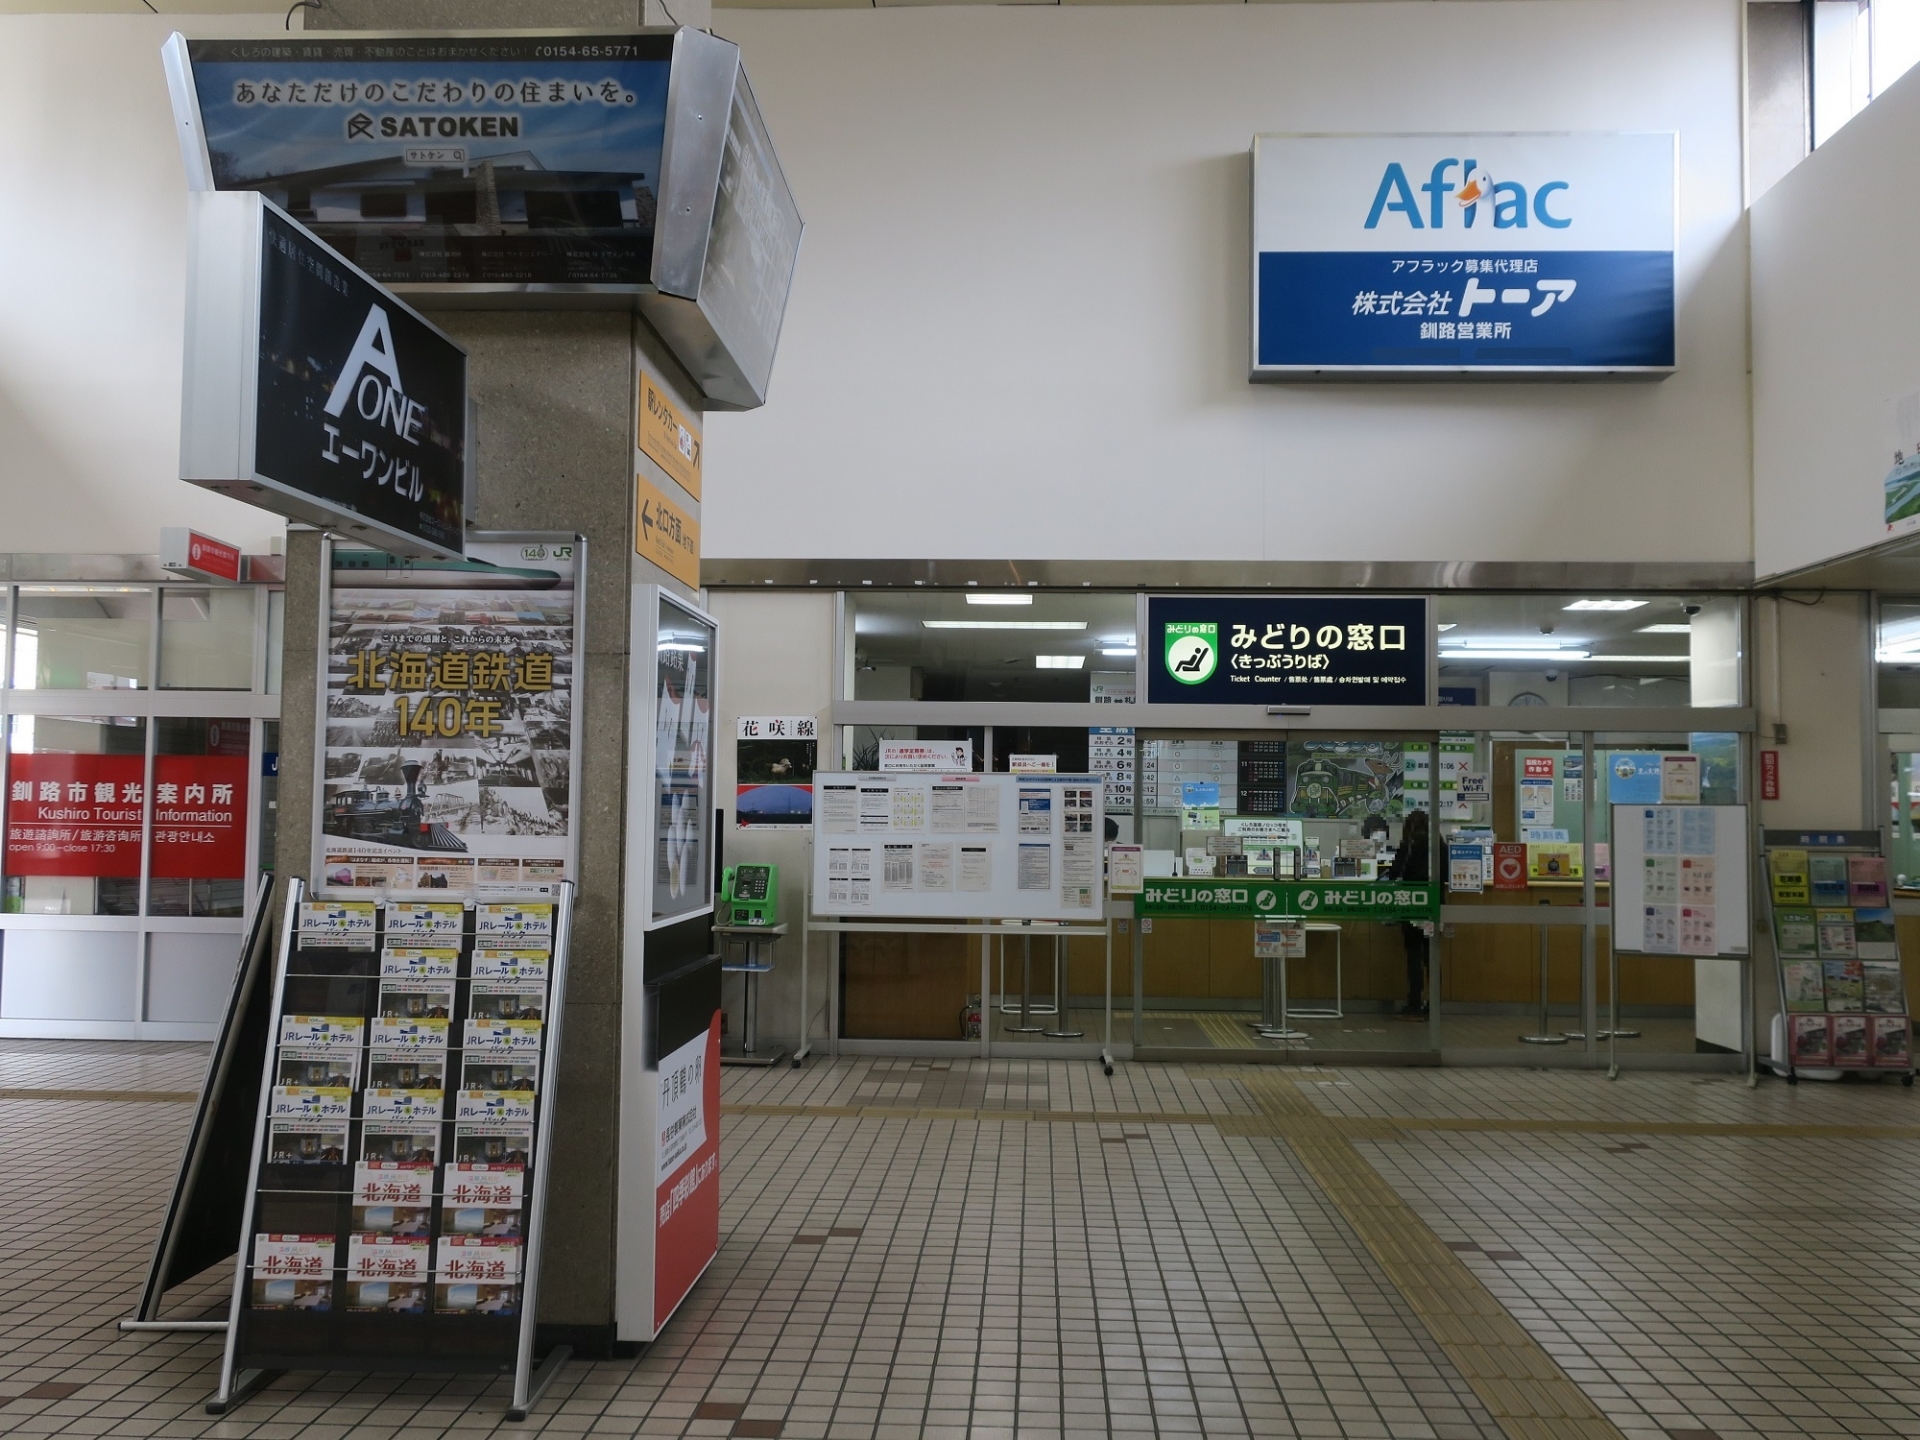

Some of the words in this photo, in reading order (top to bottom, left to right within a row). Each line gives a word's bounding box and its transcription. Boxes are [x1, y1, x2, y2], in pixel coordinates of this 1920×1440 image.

[543, 45, 640, 57] 0154-65-5771
[234, 79, 638, 105] あなただけのこだわりの住まいを。
[380, 116, 519, 138] SATOKEN
[409, 151, 445, 160] サトケン
[1363, 157, 1573, 230] Aflac
[1391, 259, 1538, 274] アフラック募集代理店
[1350, 290, 1453, 317] 株式会社
[1458, 277, 1577, 318] トーア
[1419, 321, 1512, 340] 釧路営業所
[323, 302, 404, 418] A
[357, 373, 426, 447] ONE
[647, 387, 678, 434] 駅レンタカー
[321, 422, 425, 503] エーワンビル
[655, 508, 682, 545] 北口方面
[553, 547, 572, 557] JR
[1166, 623, 1216, 634] みどりの窓口
[1231, 624, 1405, 651] みどりの窓口
[347, 650, 553, 691] 北海道鉄道
[394, 697, 503, 738] 140年
[742, 719, 814, 737] 花咲線
[1462, 776, 1484, 785] Free
[1462, 784, 1485, 793] Wi-Fi
[12, 781, 234, 805] 釧路市観光案内所
[38, 807, 90, 821] Kushiro
[94, 807, 142, 822] Tourist
[155, 808, 233, 823] Information
[1529, 830, 1566, 840] 時刻表
[8, 844, 34, 855] open
[1499, 845, 1522, 854] AED
[1145, 887, 1249, 904] みどりの窓口
[1324, 890, 1429, 905] みどりの窓口
[362, 1182, 422, 1203] 北海道
[452, 1183, 512, 1204] 北海道
[263, 1255, 323, 1276] 北海道
[355, 1257, 417, 1278] 北海道
[446, 1258, 507, 1279] 北海道
